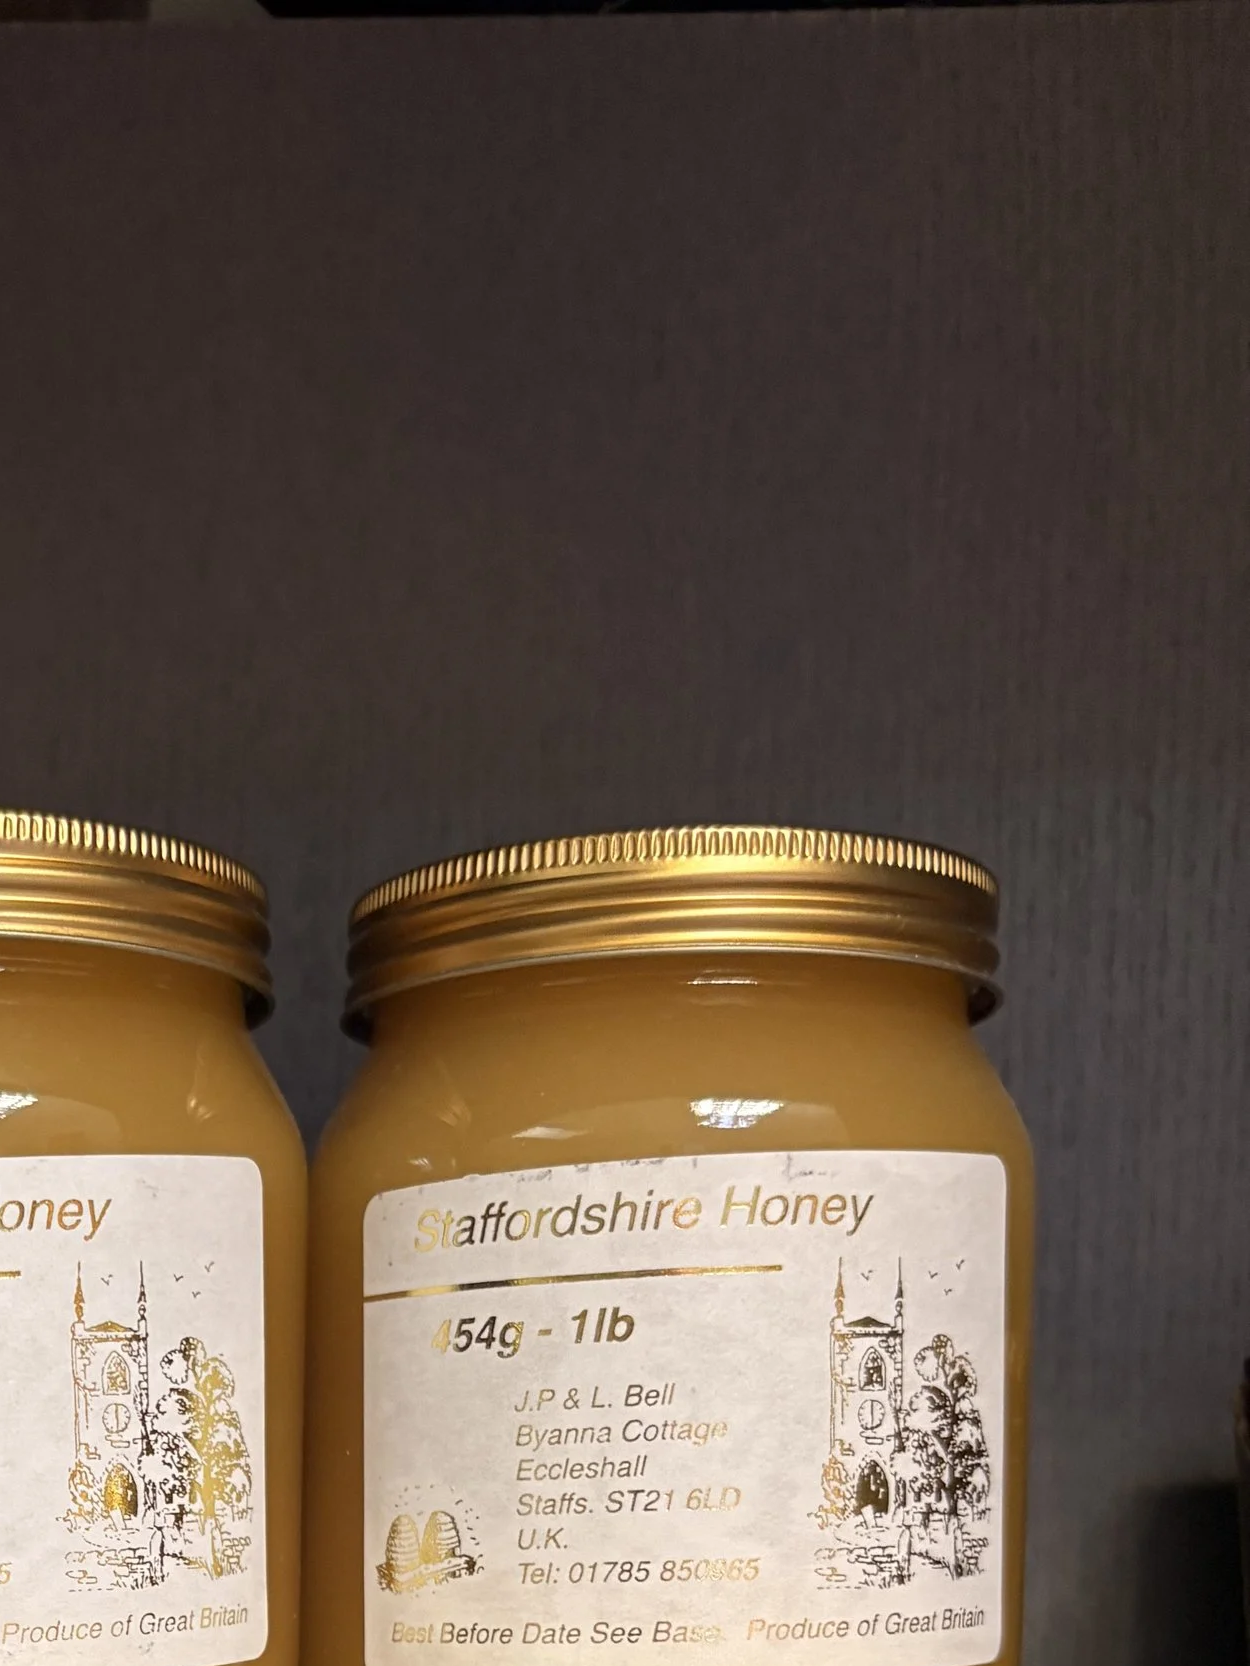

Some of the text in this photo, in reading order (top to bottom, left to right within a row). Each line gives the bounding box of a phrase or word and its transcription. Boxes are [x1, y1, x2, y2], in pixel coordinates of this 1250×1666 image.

[413, 1185, 874, 1253] Staffordshire Honey
[432, 1308, 635, 1359] 454g 1lb
[514, 1384, 675, 1413] J.P L. Bell
[516, 1419, 728, 1448] Byanna Cottage
[517, 1456, 646, 1481] Eccleshall
[517, 1490, 674, 1515] Staffs. ST21
[518, 1528, 568, 1550] U.K.
[519, 1561, 649, 1586] Tel: 01785
[2, 1619, 102, 1647] Produce
[111, 1613, 131, 1638] of
[139, 1610, 194, 1636] Great
[200, 1604, 248, 1630] Britain
[440, 1606, 985, 1645] Before Date See Produce of Great Britain
